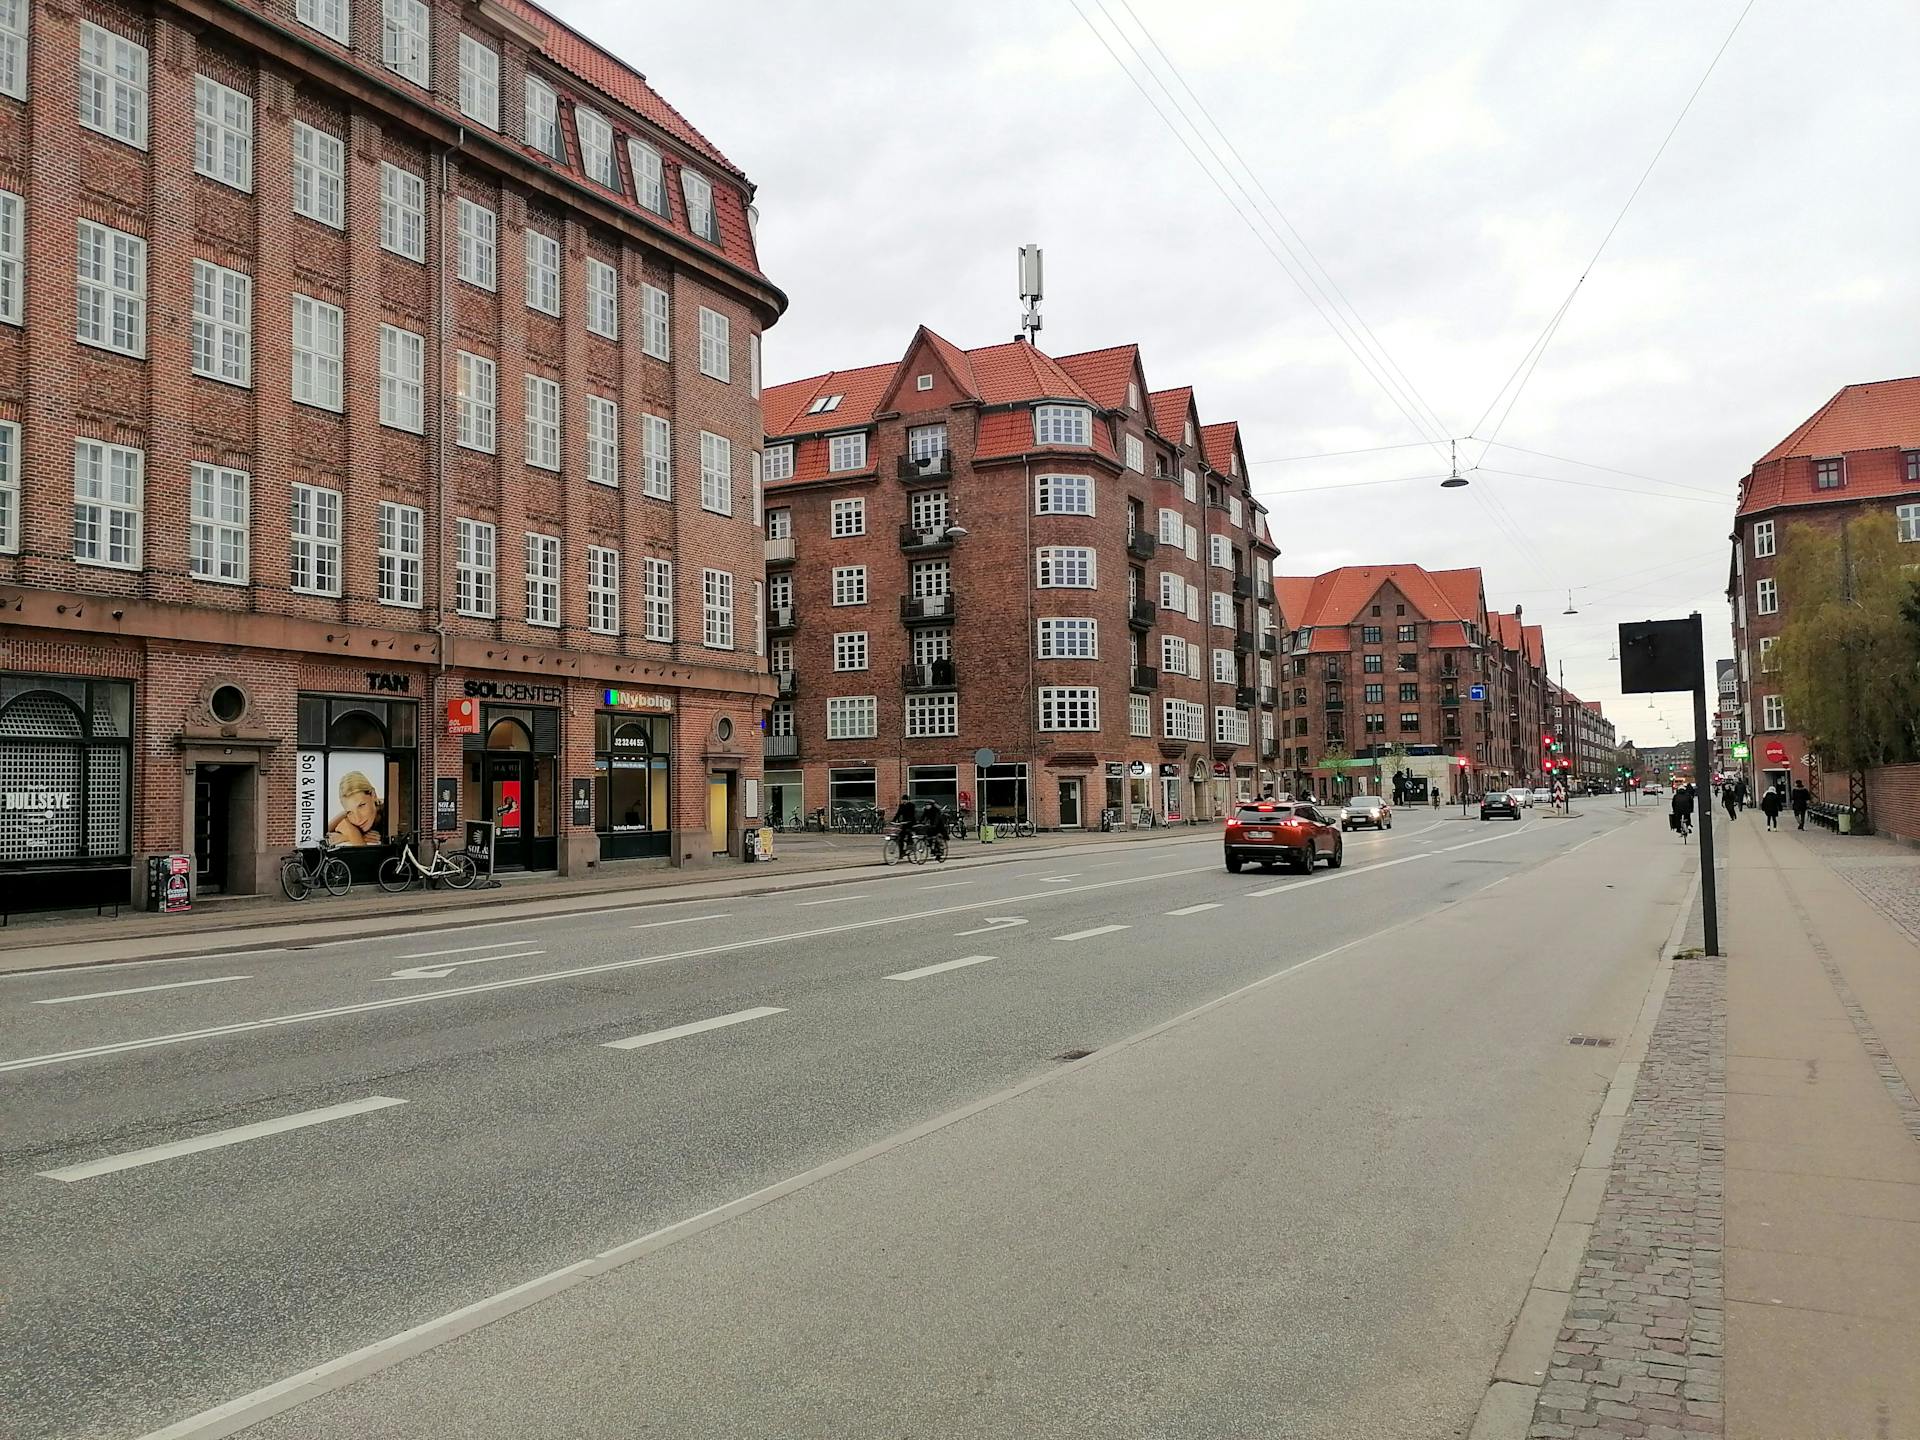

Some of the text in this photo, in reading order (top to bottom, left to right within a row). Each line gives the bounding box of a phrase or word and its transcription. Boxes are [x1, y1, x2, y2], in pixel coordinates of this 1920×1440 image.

[367, 672, 409, 692] TAN
[464, 680, 562, 702] SOLCENTER
[620, 692, 672, 711] Nybolig
[6, 792, 71, 810] BULLSEYE
[301, 755, 316, 843] Sol & Wellness
[468, 845, 481, 854] SOL
